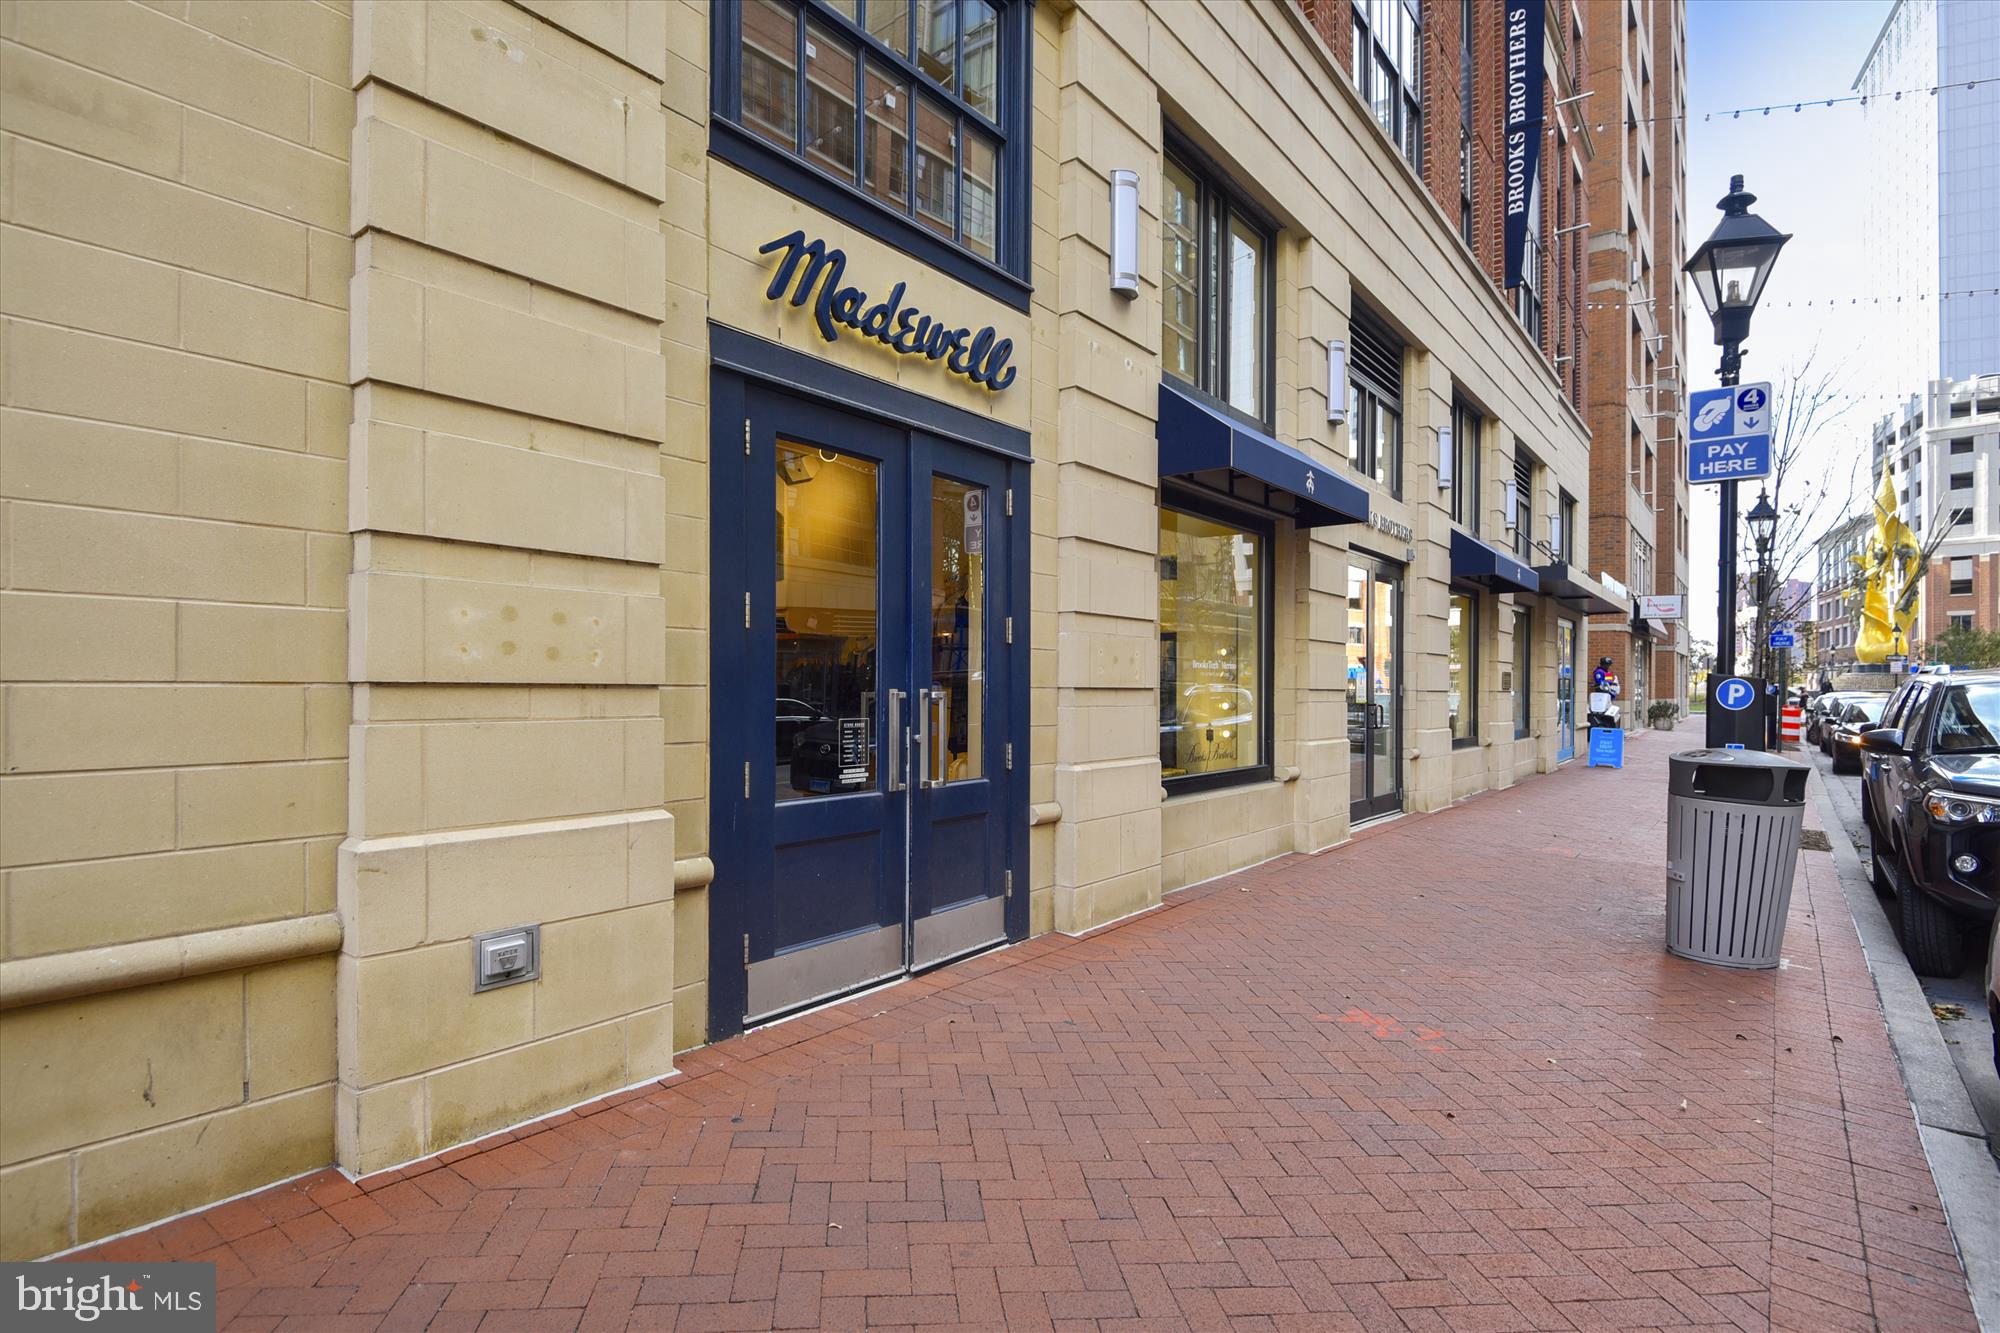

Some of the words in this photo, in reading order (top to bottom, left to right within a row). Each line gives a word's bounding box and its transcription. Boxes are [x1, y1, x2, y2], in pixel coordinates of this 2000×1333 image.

[1509, 8, 1526, 125] BROTHERS
[1508, 131, 1525, 215] BROOKS
[759, 230, 1017, 391] Madewell
[1743, 389, 1759, 404] 4
[1708, 442, 1748, 458] PAY
[1700, 458, 1757, 475] HERE
[1728, 684, 1745, 705] P
